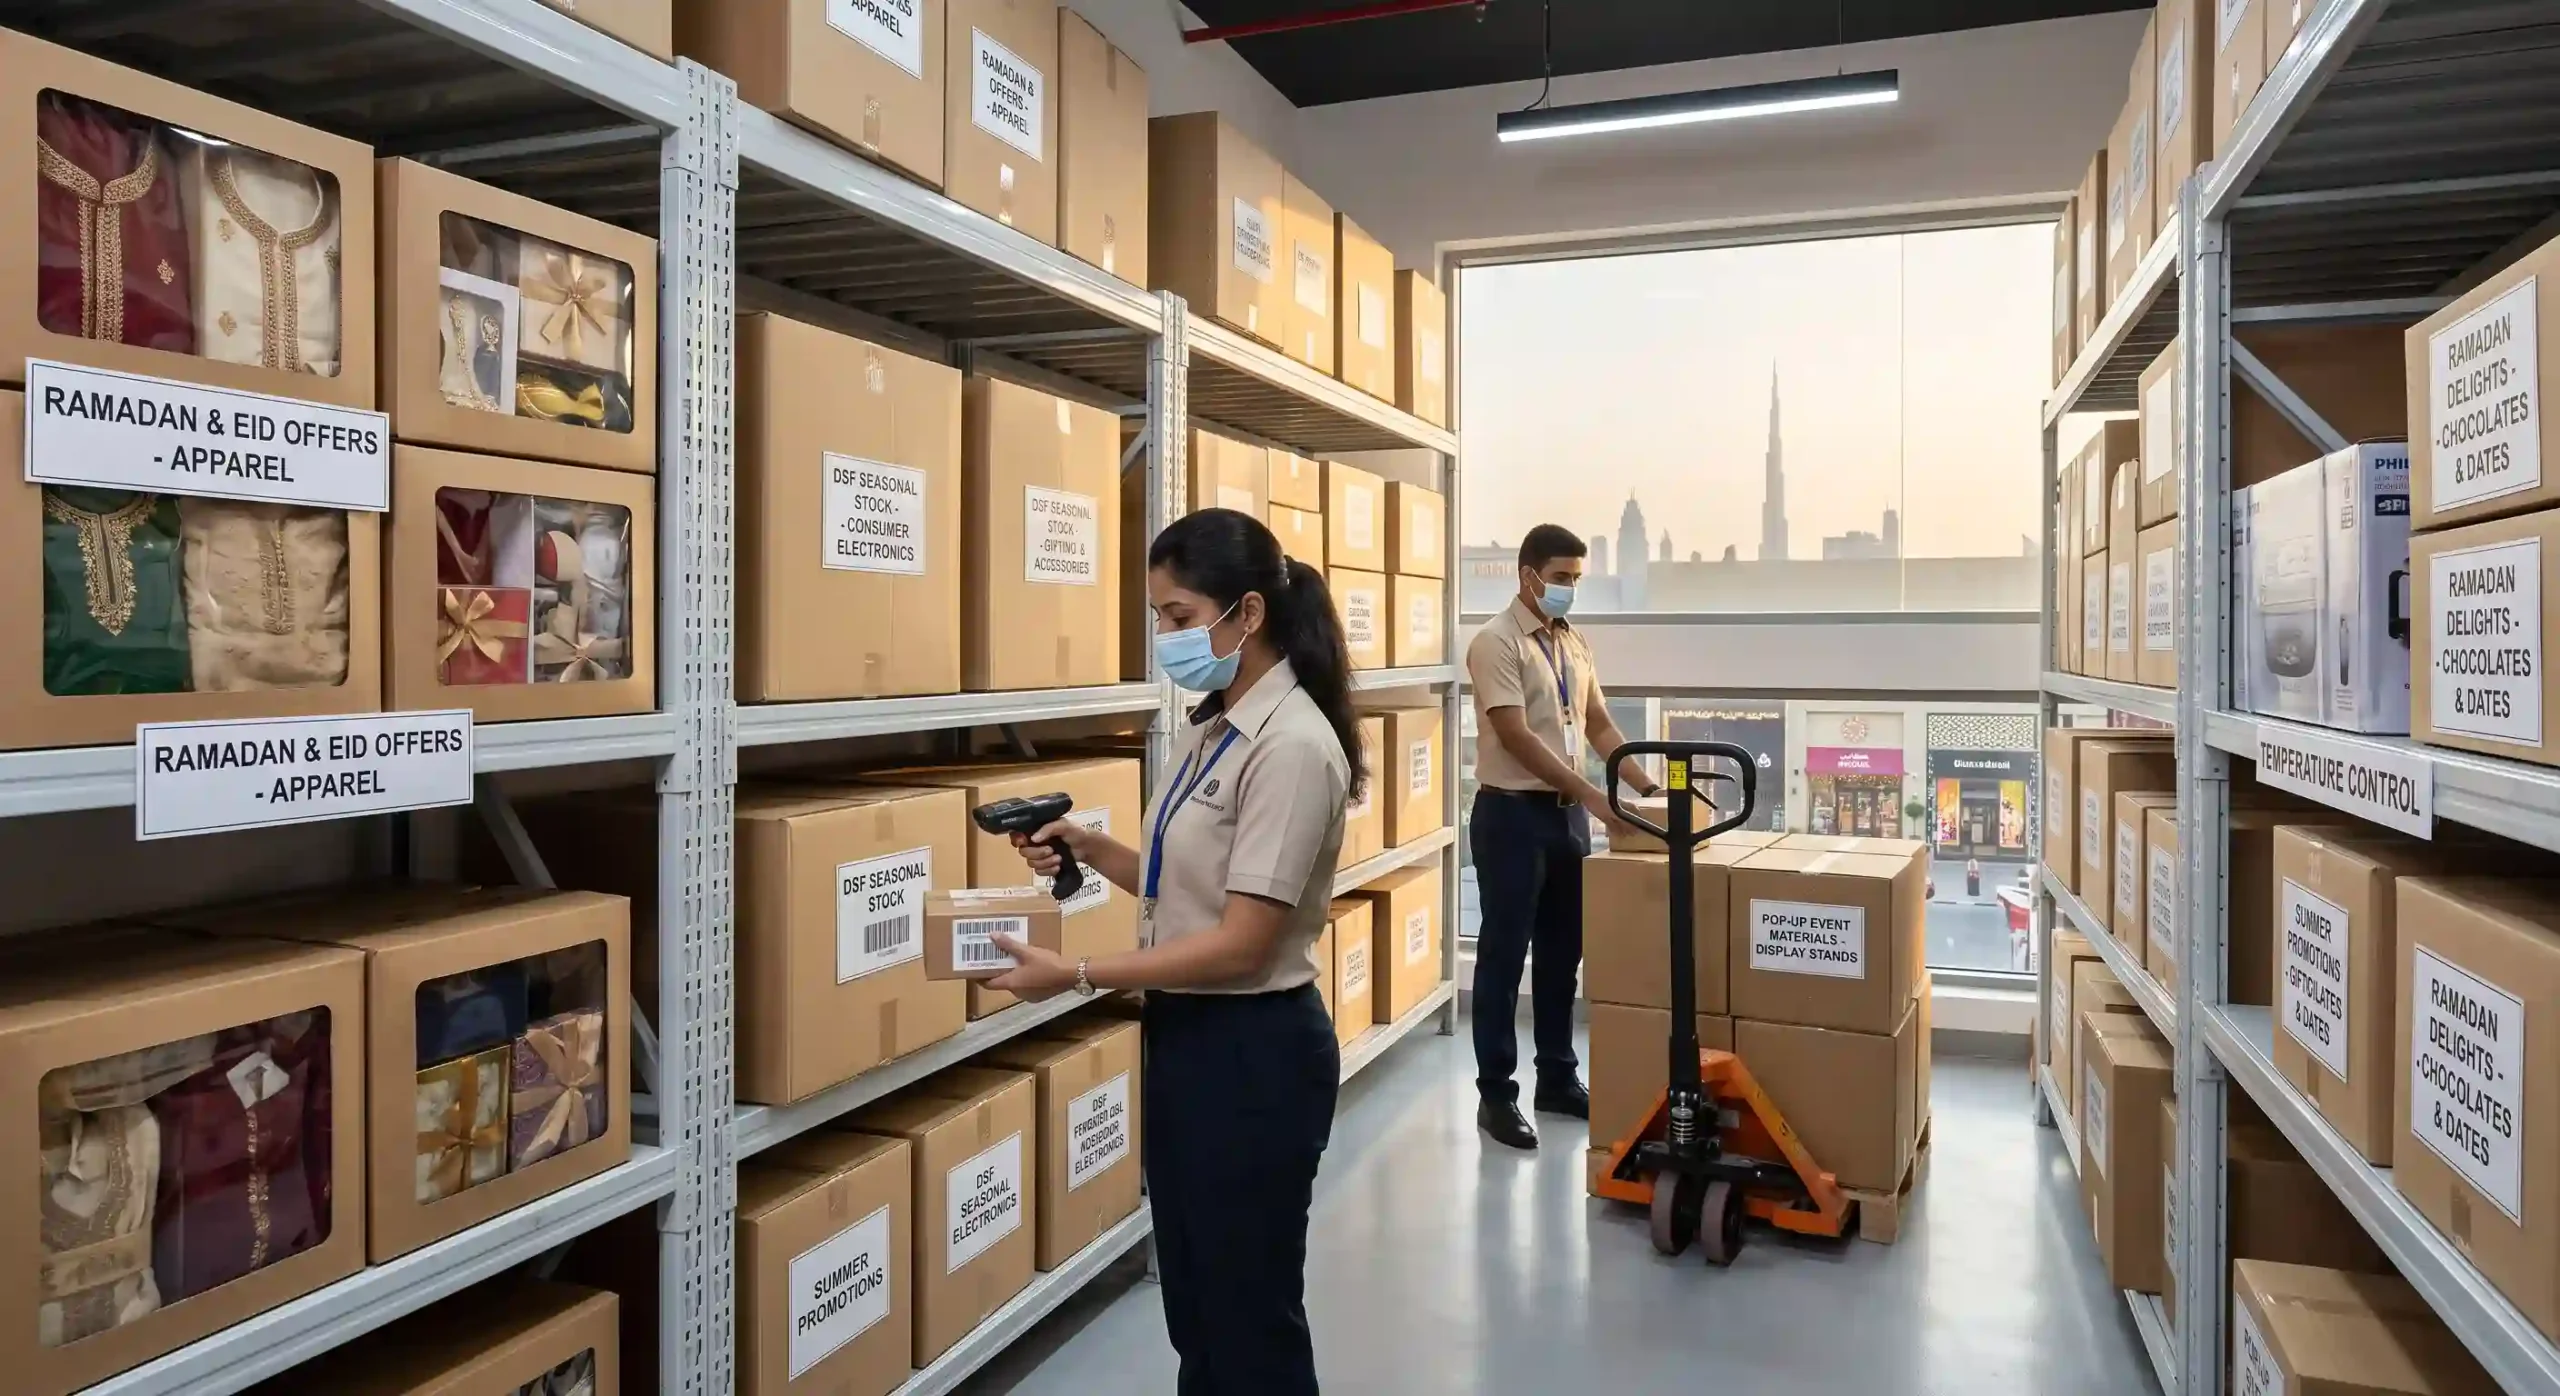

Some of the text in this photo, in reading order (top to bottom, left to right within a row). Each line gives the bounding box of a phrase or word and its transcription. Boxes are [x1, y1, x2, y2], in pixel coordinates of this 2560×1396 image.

[982, 50, 1034, 97] RAMADAN &
[989, 78, 1023, 112] OFFERS
[992, 103, 1029, 136] APPAREL
[2449, 312, 2511, 370] RAMADAN
[2448, 357, 2508, 410] DELIGHTS
[44, 386, 378, 456] RAMADAN & EID OFFERS
[2442, 391, 2528, 450] CHOCOLATES
[170, 446, 294, 483] APPAREL
[2455, 442, 2510, 484] & DATES
[833, 468, 918, 496] DSF SEASONAL
[854, 494, 892, 515] STOCK
[1032, 498, 1048, 512] DSF
[847, 516, 909, 539] CONSUMER
[1048, 520, 1074, 536] STOCK
[837, 539, 914, 562] ELECTRONICS
[1080, 543, 1085, 556] &
[2448, 564, 2516, 598] RAMADAN
[2447, 608, 2510, 636] DELIGHTS
[2442, 648, 2532, 677] CHOCOLATES
[2454, 688, 2510, 719] & DATES
[154, 728, 463, 773] RAMADAN & EID OFFERS
[270, 770, 386, 804] APPAREL
[2260, 741, 2420, 816] TEMPERATURE CONTROL
[843, 862, 926, 896] DSF SEASONAL
[868, 888, 905, 913] STOCK
[1762, 913, 1851, 930] POP-UP EVENT
[1770, 929, 1837, 945] MATERIALS
[2295, 903, 2332, 944] SUMMER
[1756, 944, 1857, 963] DISPLAY STANDS
[2288, 930, 2340, 983] PROMOTIONS
[2296, 1000, 2330, 1046] & DATES
[2431, 977, 2498, 1043] RAMADAN
[2429, 1020, 2494, 1082] DELIGHTS
[1092, 1093, 1108, 1112] DSF
[2421, 1052, 2512, 1139] CHOCOLATES
[2434, 1100, 2490, 1168] & DATES
[976, 1166, 995, 1190] DSF
[960, 1178, 1011, 1219] SEASONAL
[952, 1192, 1017, 1246] ELECTRONICS
[814, 1252, 869, 1300] SUMMER
[798, 1266, 884, 1338] PROMOTIONS
